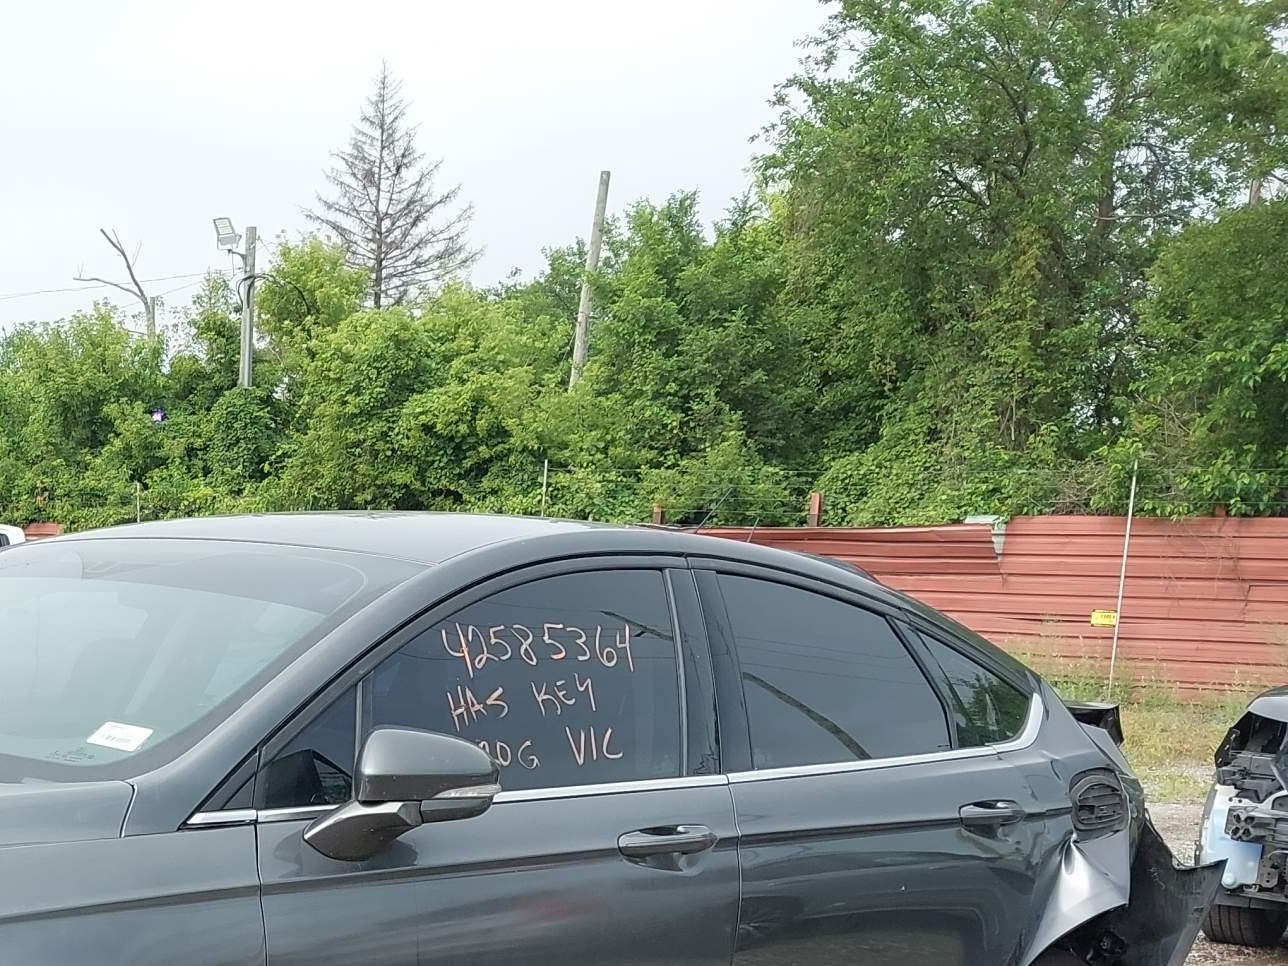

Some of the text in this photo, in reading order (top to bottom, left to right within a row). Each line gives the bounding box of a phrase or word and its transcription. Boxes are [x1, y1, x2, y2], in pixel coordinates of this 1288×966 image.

[441, 621, 634, 679] 42585364
[446, 671, 597, 733] HAS KEY
[565, 725, 624, 766] VIC
